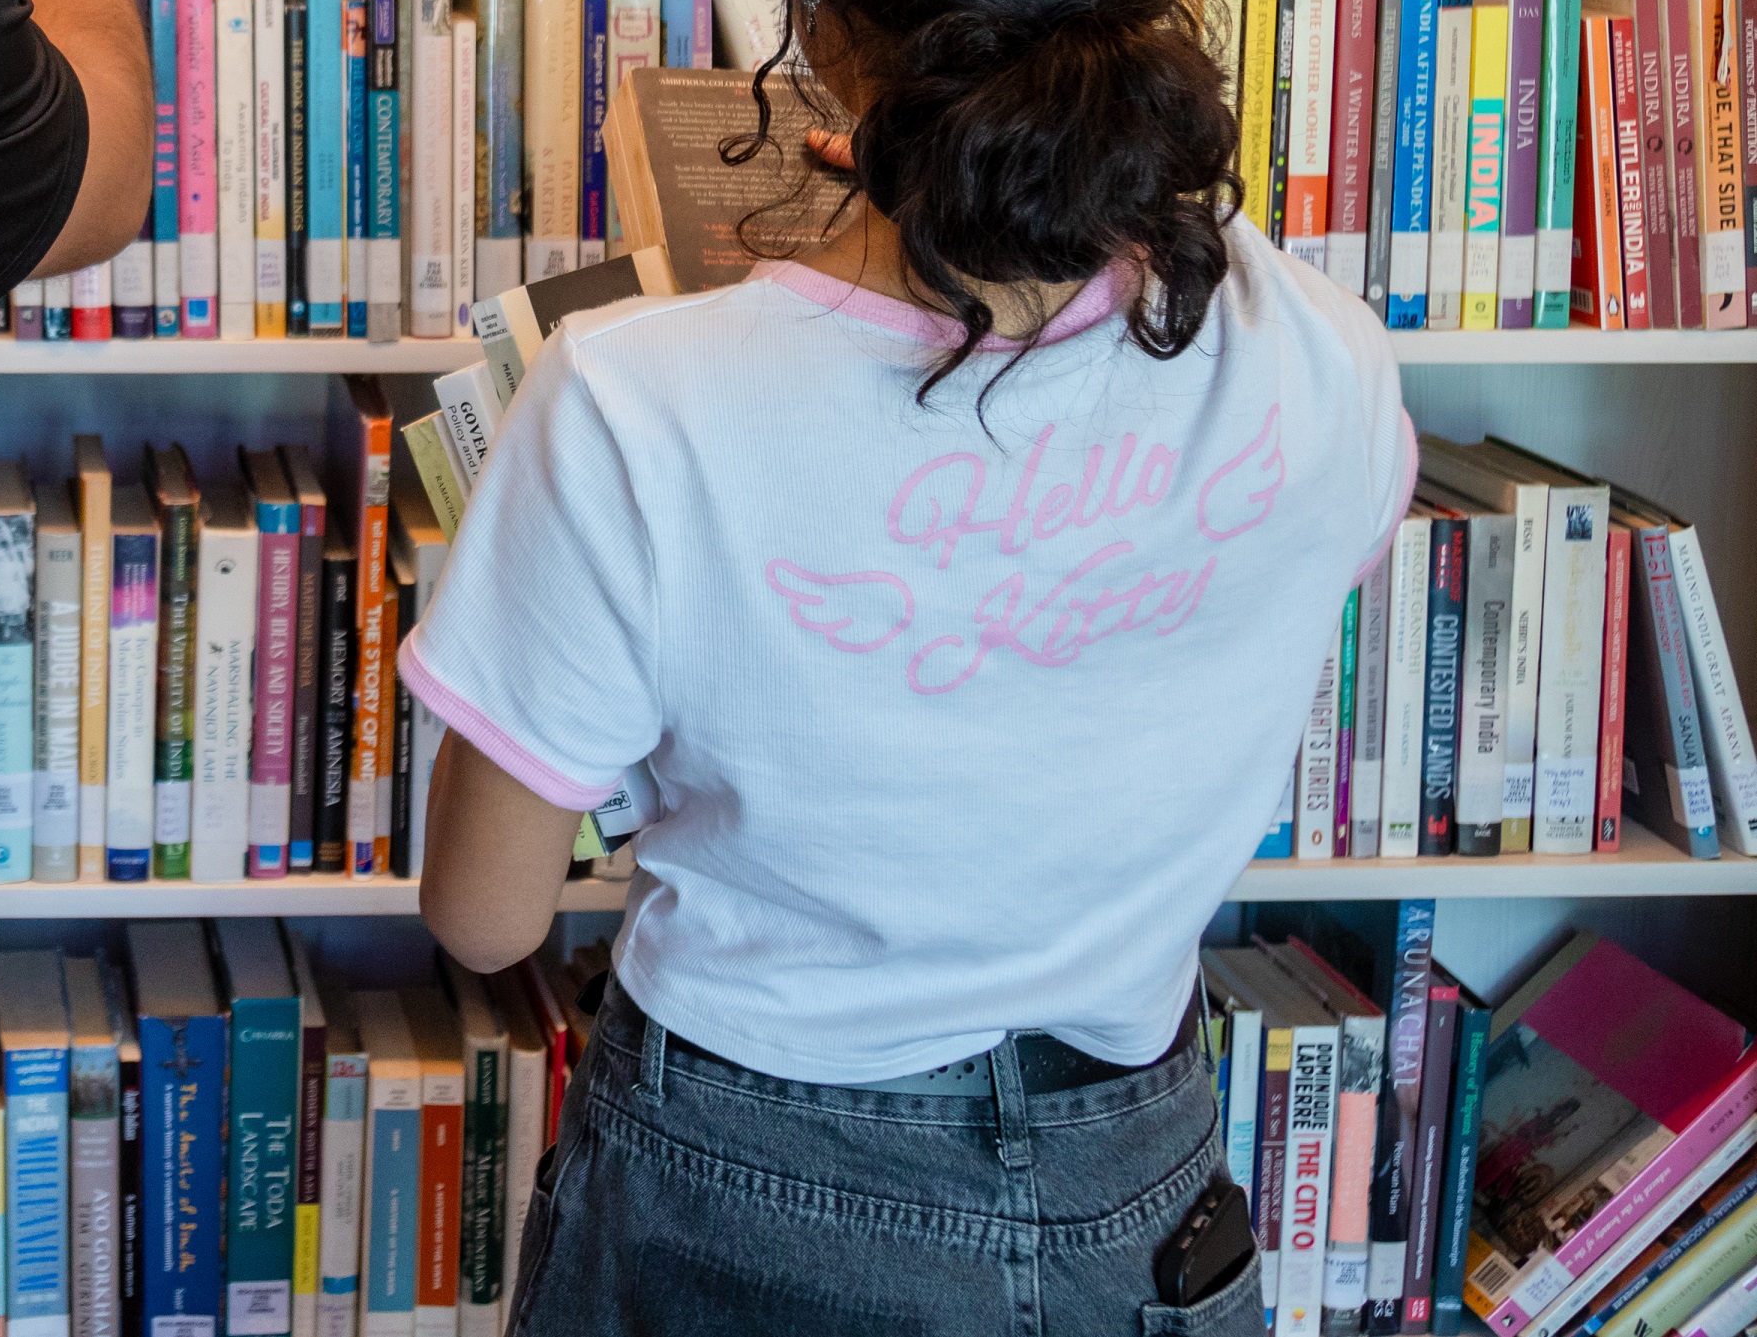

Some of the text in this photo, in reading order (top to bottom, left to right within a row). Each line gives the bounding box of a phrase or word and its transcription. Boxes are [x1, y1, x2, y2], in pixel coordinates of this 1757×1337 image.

[1308, 34, 1321, 94] OTHER
[1416, 48, 1429, 106] AFTER
[1517, 79, 1535, 150] INDIA
[1673, 53, 1690, 128] INDIRA
[375, 94, 392, 224] CONTEMPORARY
[1305, 99, 1318, 164] MOHAN
[1344, 69, 1362, 184] A WINTER IN
[1469, 113, 1500, 228] INDIA
[1717, 122, 1736, 230] THAT SIDE
[1618, 119, 1644, 276] HITLER INDIA
[481, 314, 497, 322] OXFORD
[482, 328, 507, 339] PAPERBACKS
[447, 404, 477, 467] Policy and
[886, 423, 1218, 696] Hello Kitty
[324, 629, 347, 807] MEMORY AMNESIA
[361, 604, 382, 747] THE STORY OF
[1426, 613, 1458, 799] CONTESTED LANDS
[1476, 600, 1504, 753] Contemporary India
[1392, 906, 1429, 1092] ARUNACHAL
[1293, 1045, 1315, 1128] LAPIERRE
[1312, 1044, 1332, 1129] DOMINIQUE
[238, 1112, 265, 1232] LANDSCAPE
[264, 1114, 292, 1228] THE TODA
[1294, 1141, 1320, 1227] THE CITY
